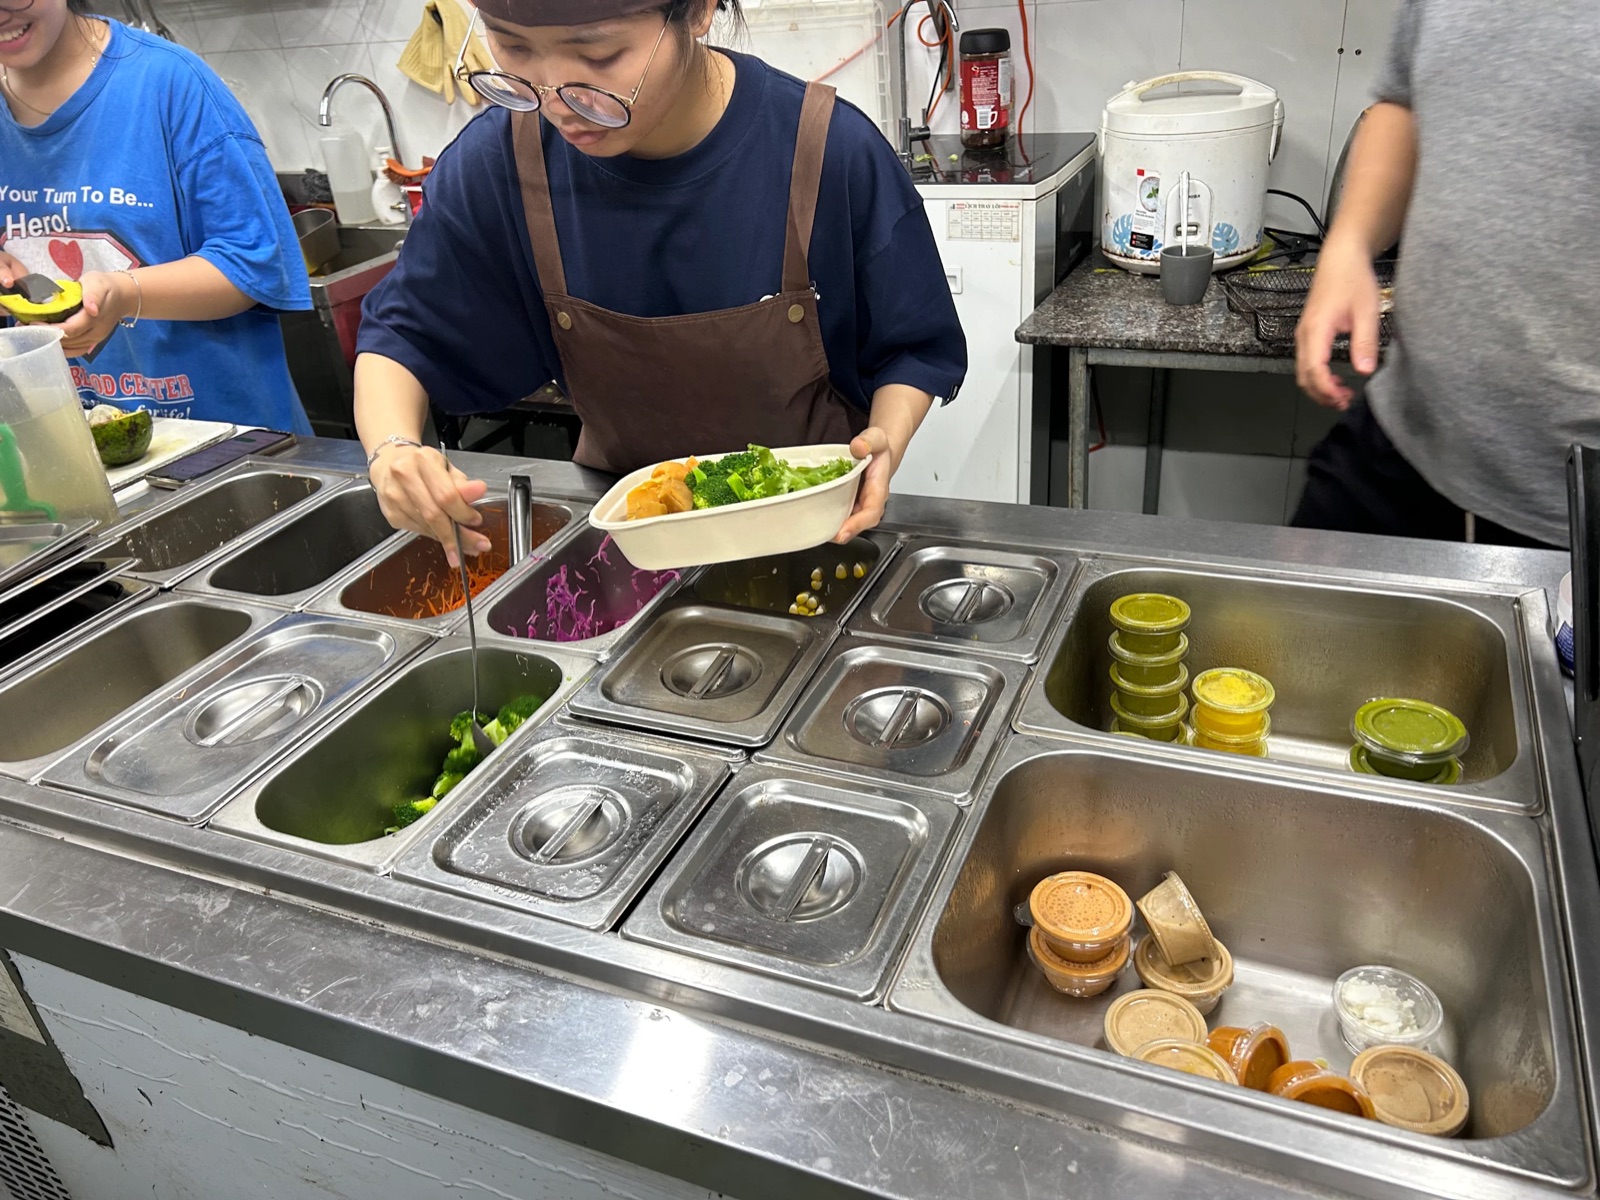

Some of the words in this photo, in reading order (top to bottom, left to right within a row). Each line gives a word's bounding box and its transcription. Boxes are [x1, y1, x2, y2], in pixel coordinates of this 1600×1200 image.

[0, 185, 38, 203] Your
[80, 186, 104, 203] To
[109, 187, 154, 208] Be...
[5, 205, 72, 240] Hero!
[69, 365, 117, 397] BLOD
